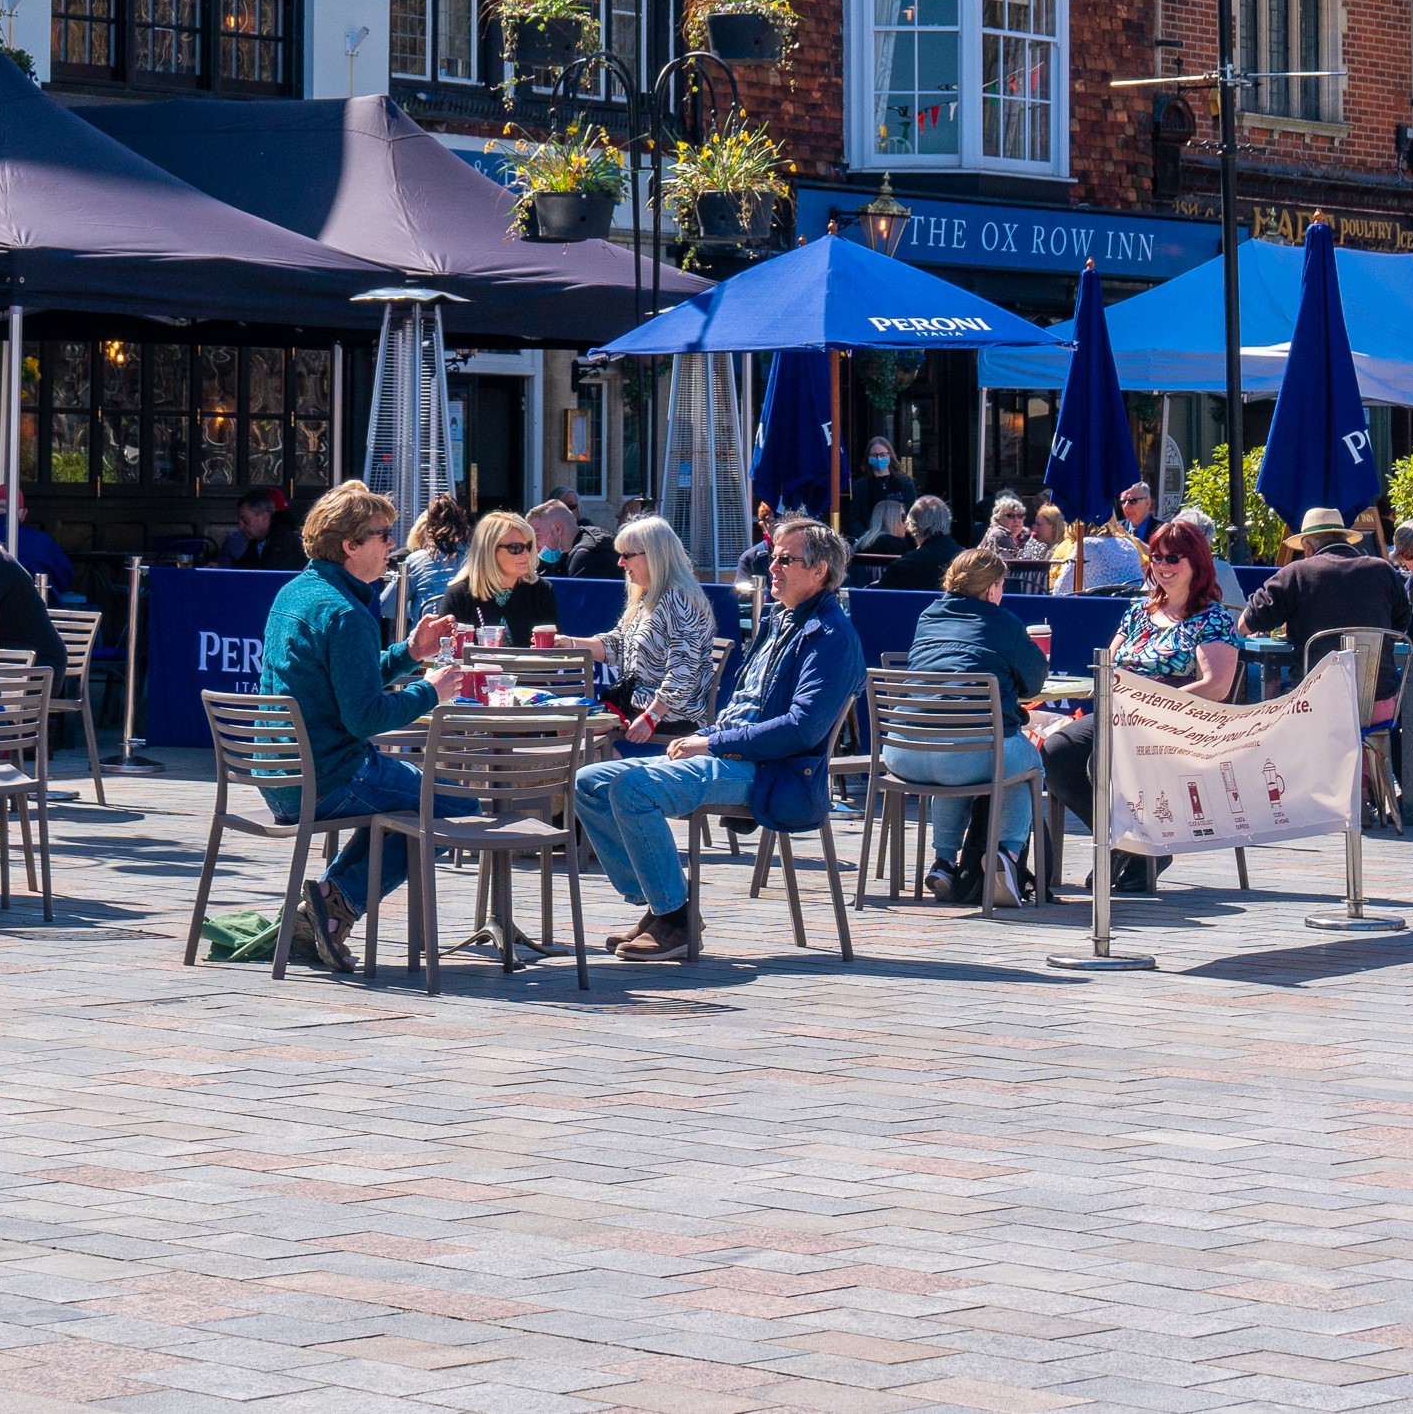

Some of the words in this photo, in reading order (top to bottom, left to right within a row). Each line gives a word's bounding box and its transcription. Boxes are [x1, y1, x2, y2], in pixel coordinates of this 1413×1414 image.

[908, 215, 967, 249] THE
[981, 221, 1019, 253] OX
[1031, 225, 1095, 257] ROW
[1105, 231, 1155, 262] INN
[1340, 217, 1393, 245] POULTRY
[867, 317, 992, 332] PERONI
[1361, 513, 1375, 523] INN
[198, 631, 264, 674] PER
[235, 681, 259, 693] ITA
[1130, 690, 1193, 712] external
[1185, 706, 1228, 730] seating
[1127, 708, 1159, 727] down
[1156, 722, 1193, 737] and
[1185, 730, 1224, 747] enjoy
[1214, 730, 1247, 748] your
